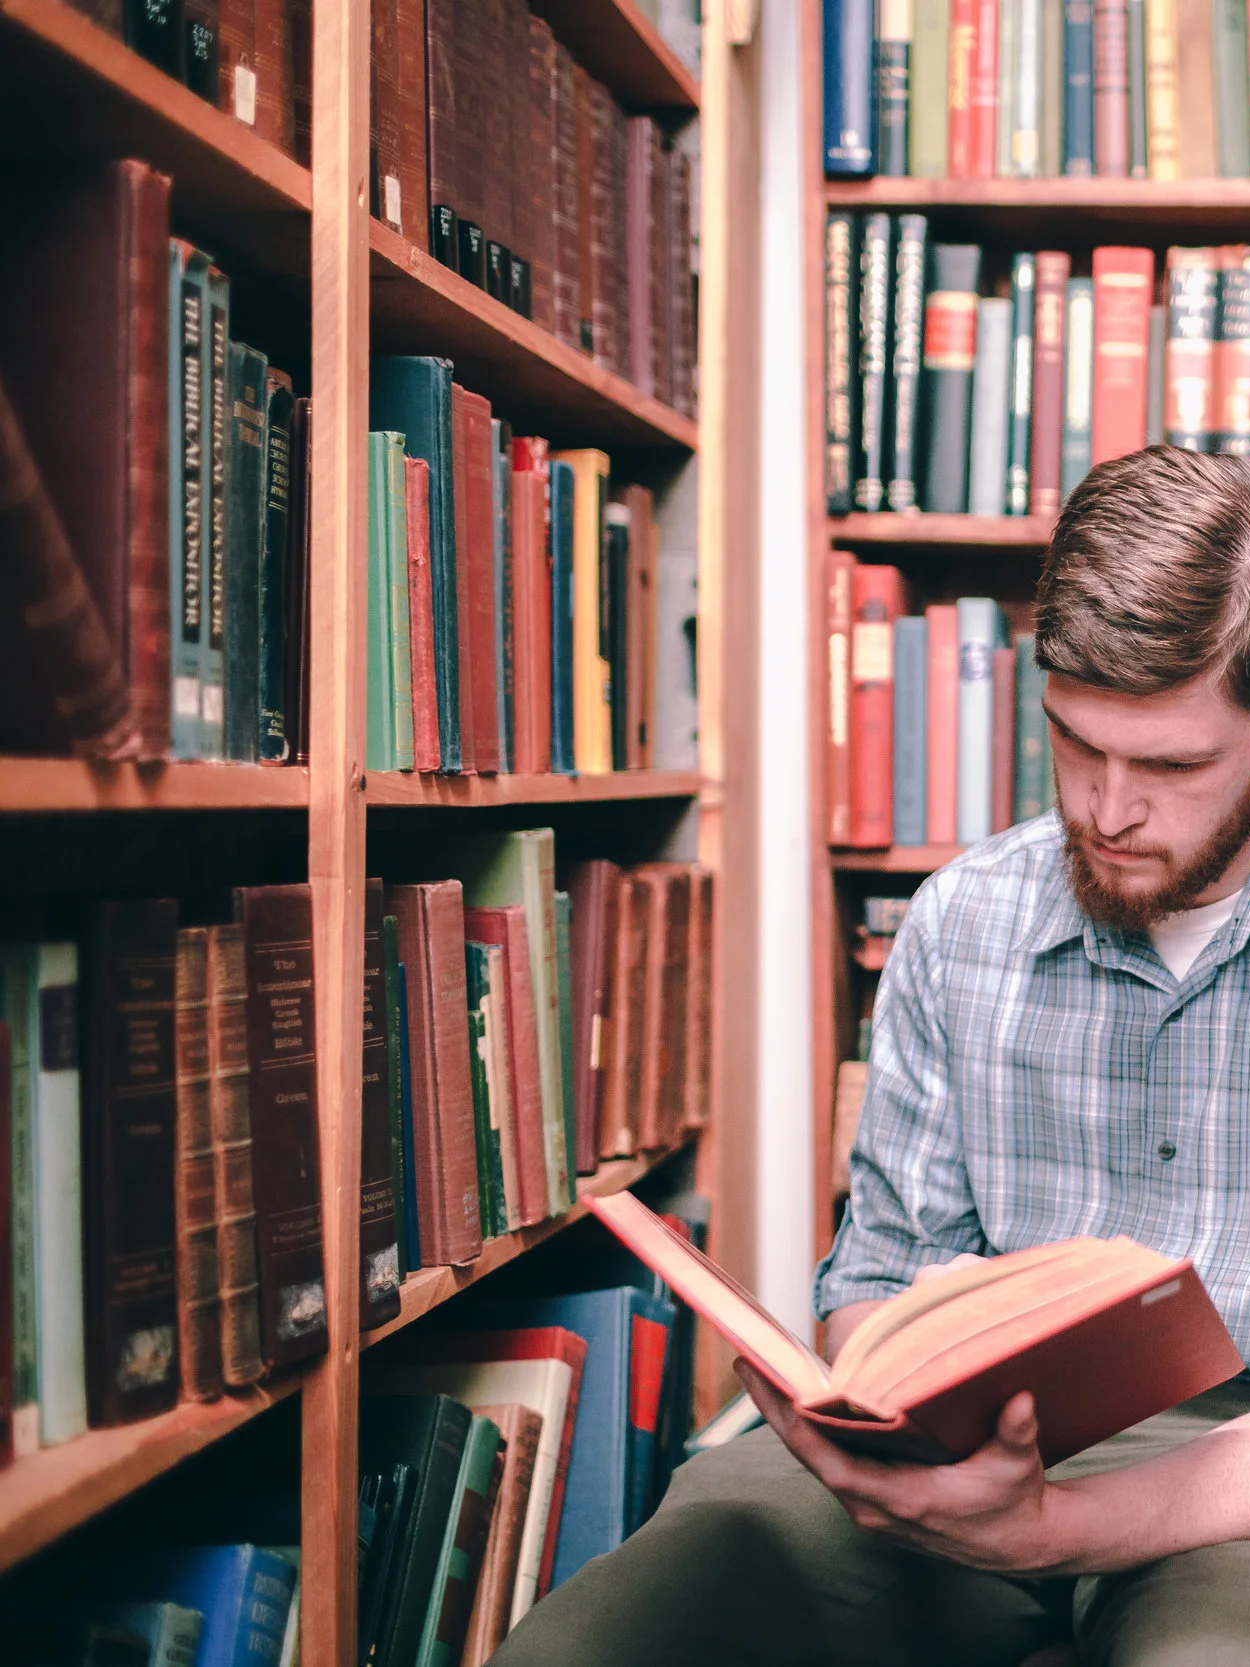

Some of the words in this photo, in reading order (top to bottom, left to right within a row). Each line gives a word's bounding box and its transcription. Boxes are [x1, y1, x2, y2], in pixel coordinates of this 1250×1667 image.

[185, 295, 200, 346] THE
[213, 320, 225, 367] THE
[185, 356, 200, 470] BIBLICAL
[213, 376, 225, 487] BIBLICAL
[185, 480, 200, 628] EXPOSITOR
[213, 496, 225, 636] EXPOSITOR
[273, 959, 297, 971] The
[274, 1037, 304, 1050] Bible
[275, 1092, 309, 1105] Green
